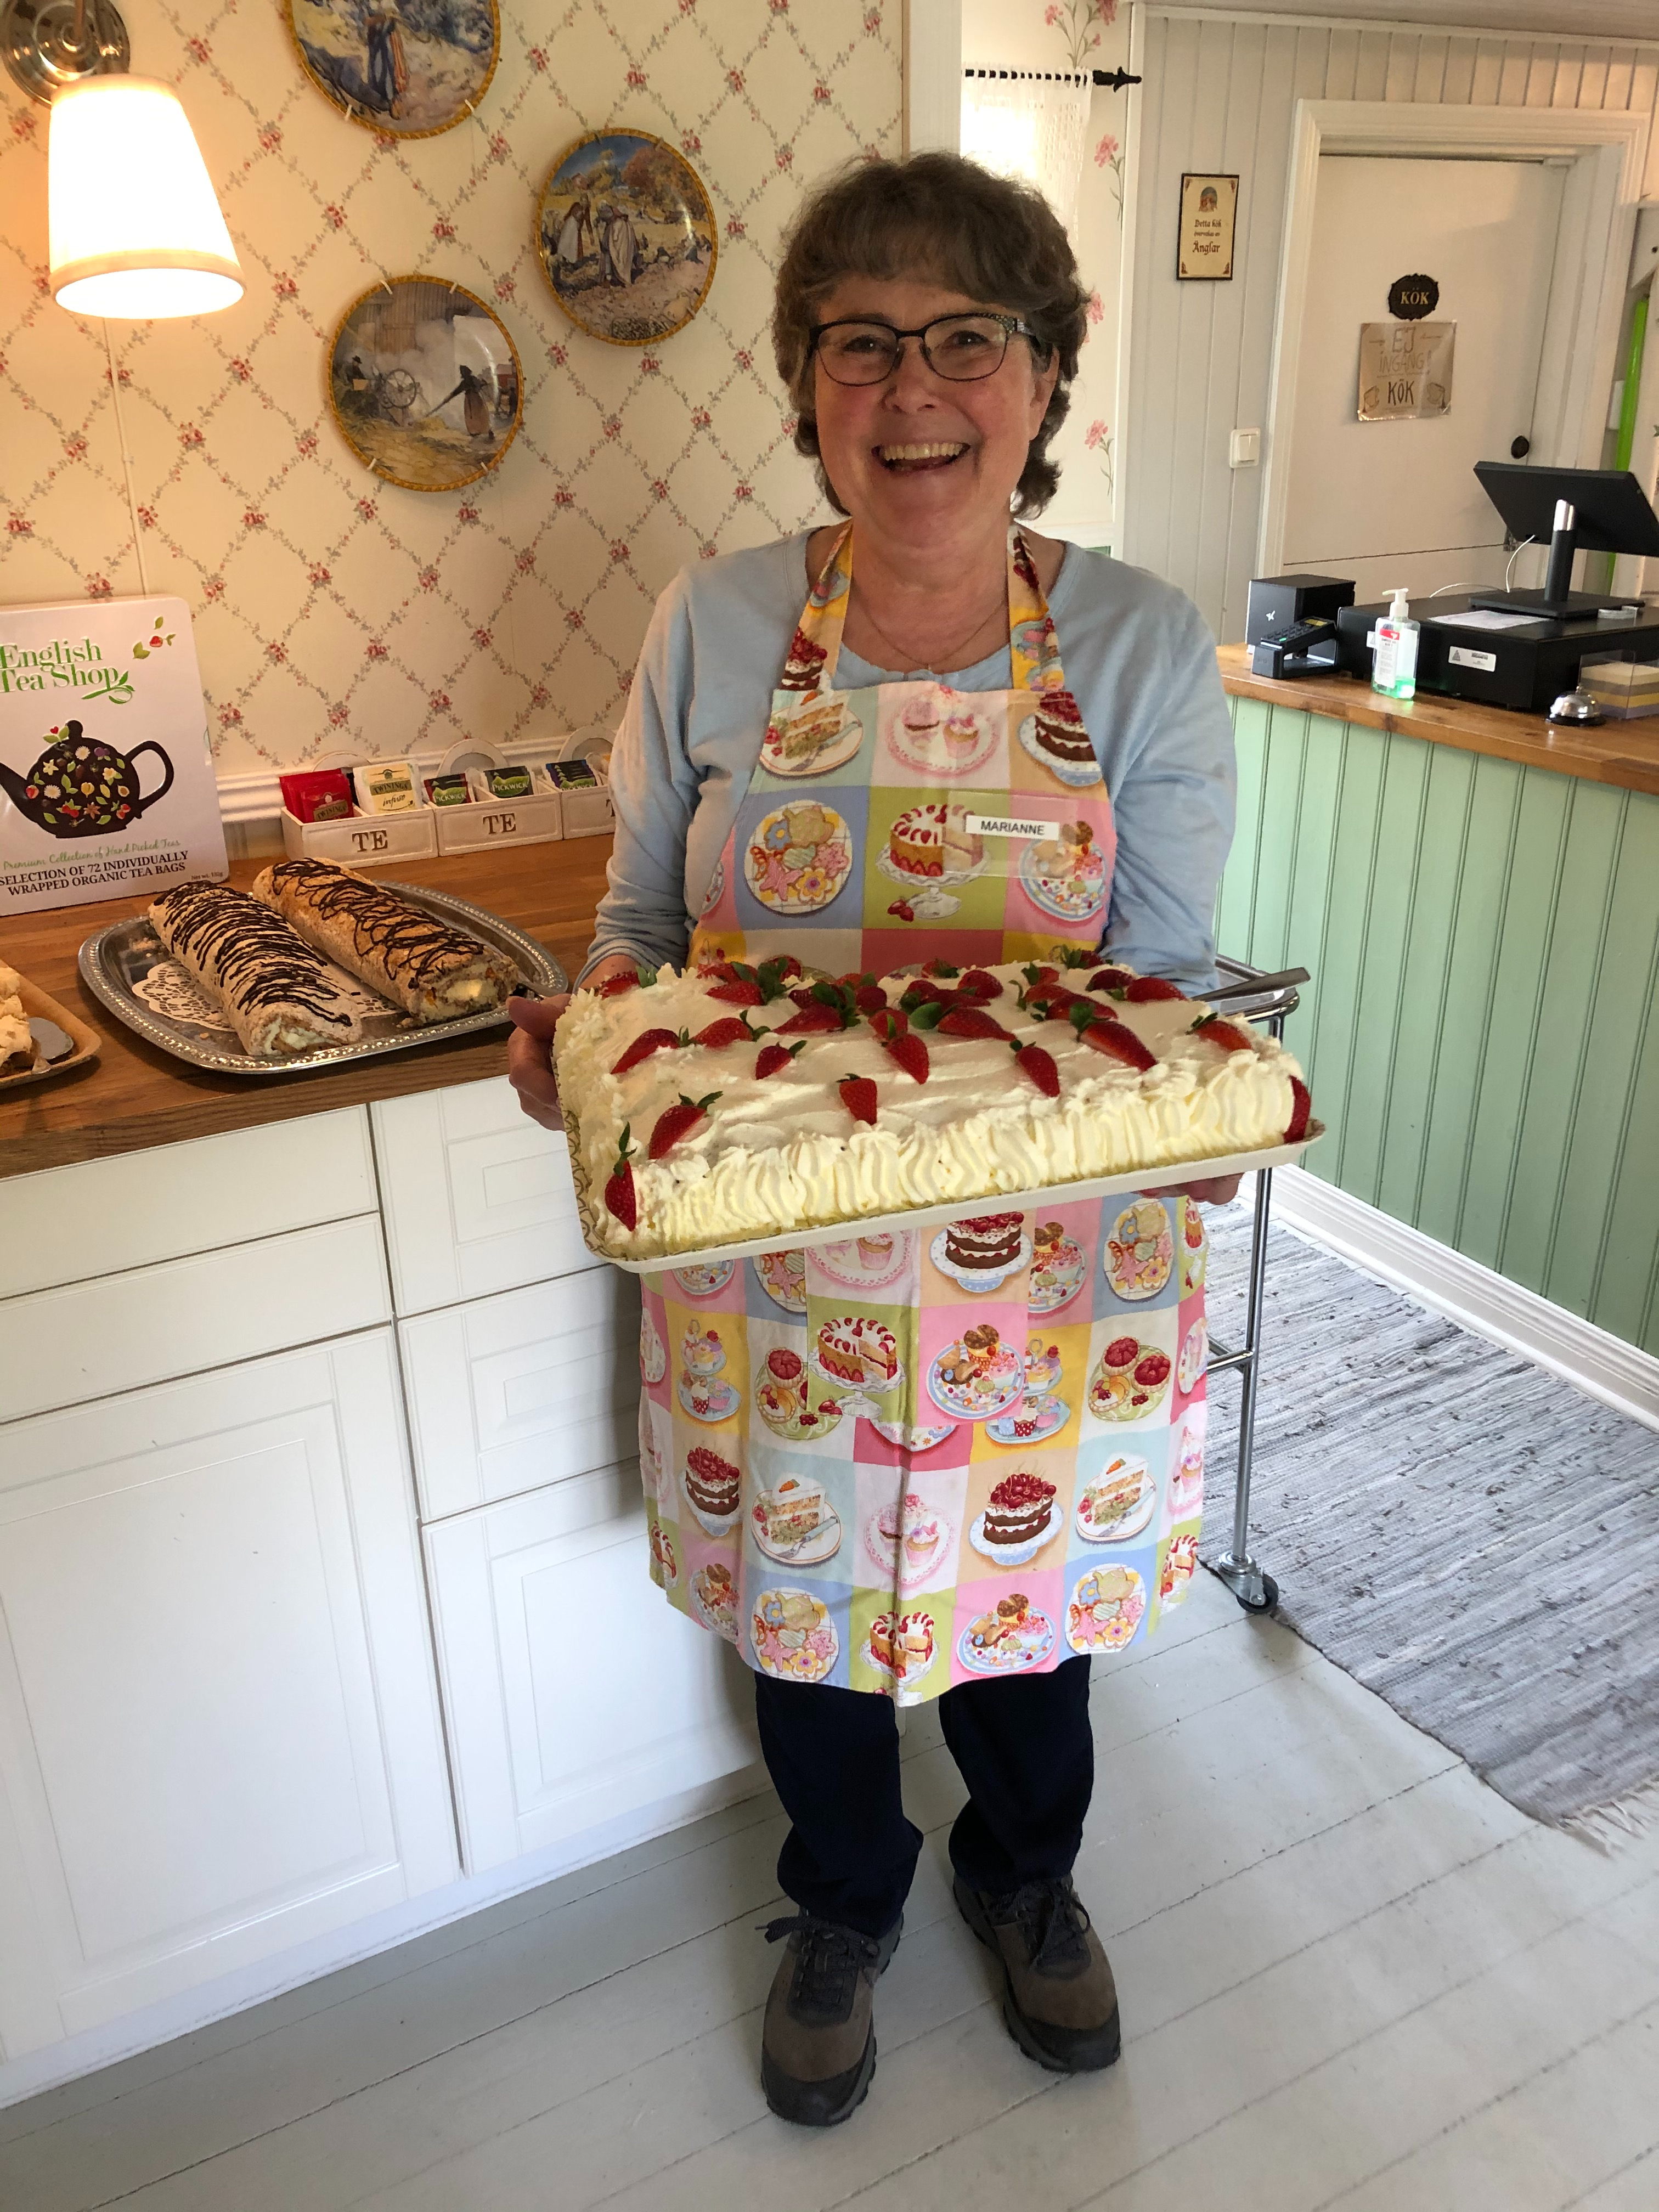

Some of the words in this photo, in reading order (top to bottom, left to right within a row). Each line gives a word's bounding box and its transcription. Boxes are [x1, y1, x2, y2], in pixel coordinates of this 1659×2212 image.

[1194, 219, 1211, 228] Detta
[1401, 287, 1430, 305] KÖK
[1392, 326, 1417, 353] EJ
[1387, 379, 1415, 407] KÖK
[0, 636, 103, 672] English
[0, 668, 46, 693] Tea
[50, 662, 119, 691] Shop
[374, 780, 408, 795] TWININGS
[434, 792, 466, 804] PICKWICK
[493, 781, 528, 793] PICKWICK
[316, 805, 347, 821] TWININGS
[482, 812, 517, 834] TE
[980, 820, 1045, 836] MARIANNE
[352, 830, 388, 853] TE
[3, 859, 47, 871] Premium
[49, 851, 93, 864] Collection
[94, 845, 104, 860] of
[105, 843, 129, 857] Hand
[132, 839, 159, 853] Picked
[160, 838, 181, 848] Teas
[0, 867, 67, 887] SELECTION
[69, 865, 86, 876] OF
[87, 863, 101, 873] 72
[103, 850, 189, 871] INDIVIDUALLY
[8, 878, 70, 896] WRAPPED
[72, 871, 128, 887] ORGANIC
[129, 866, 153, 878] TEA
[155, 862, 186, 875] BAGS
